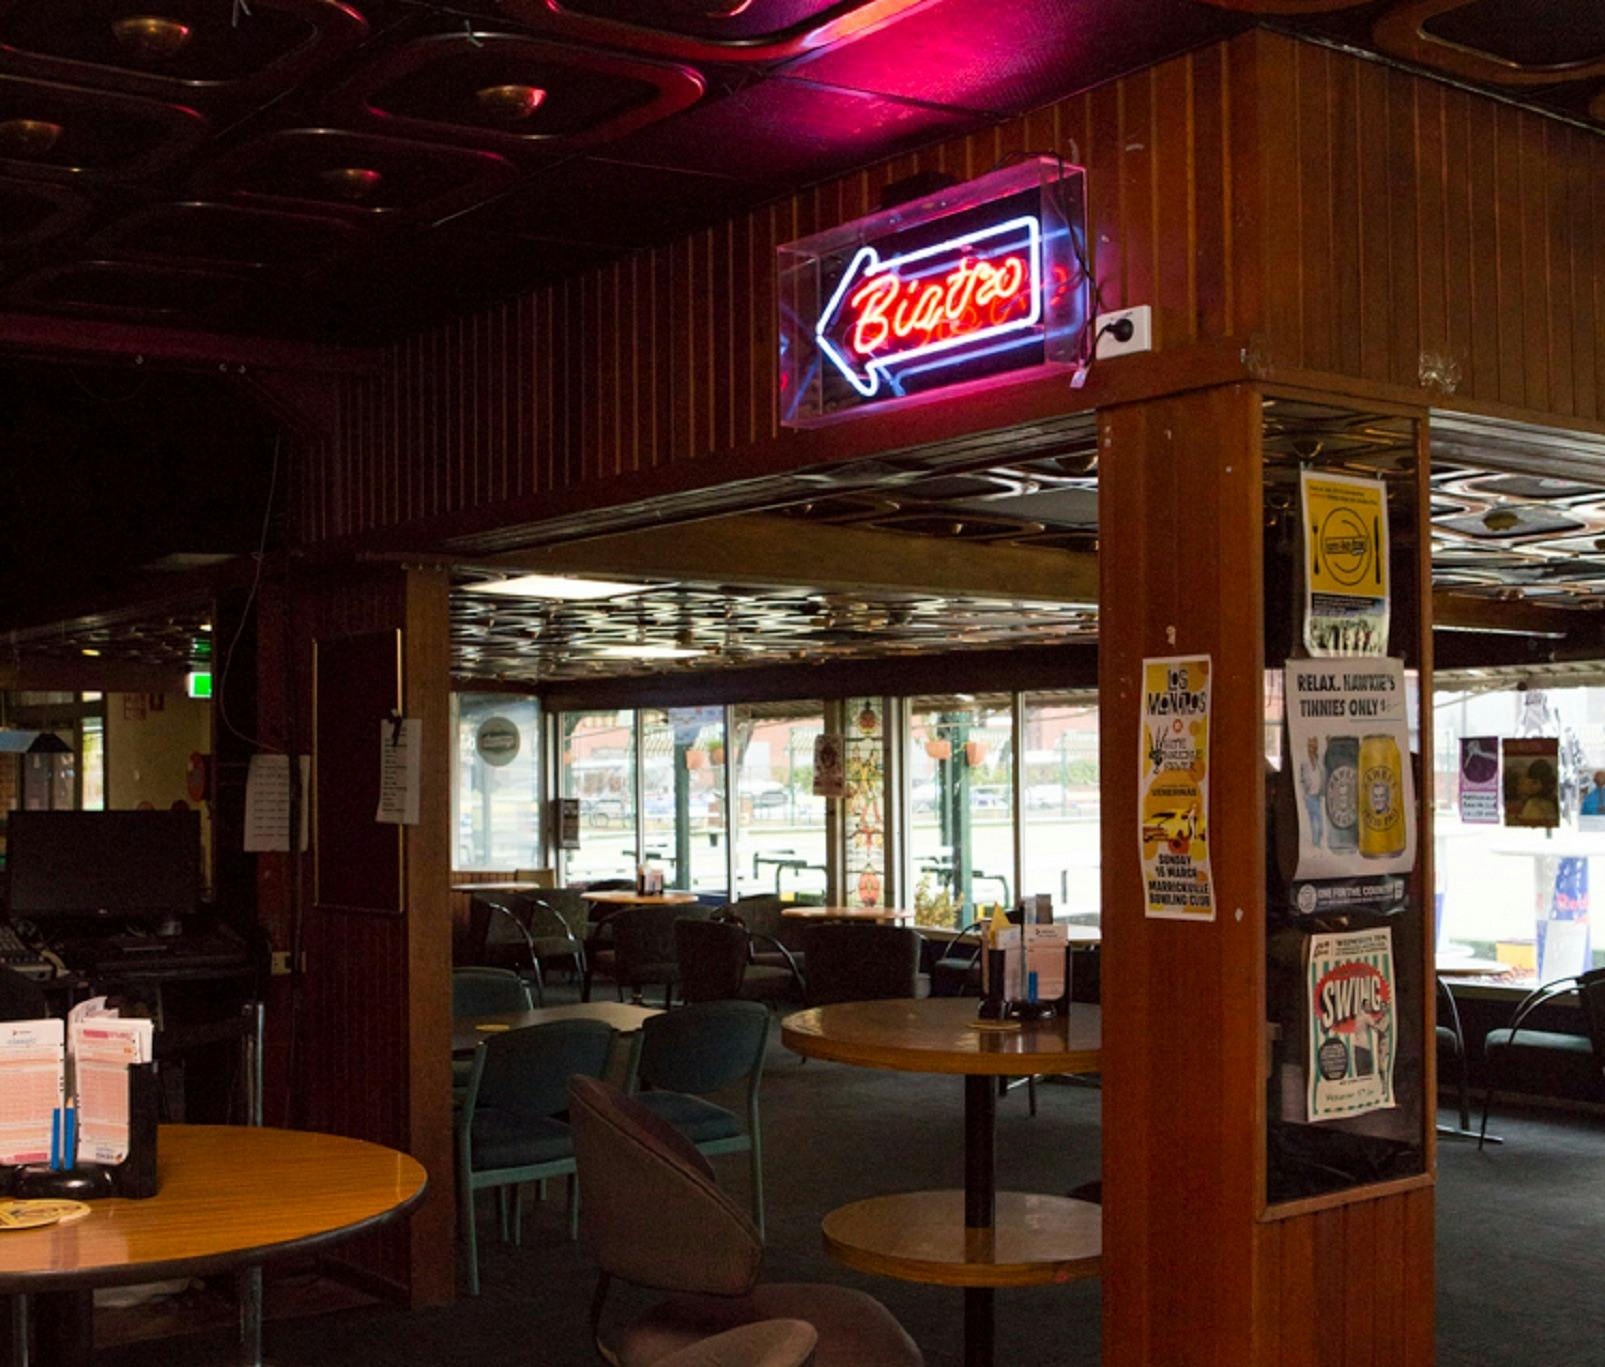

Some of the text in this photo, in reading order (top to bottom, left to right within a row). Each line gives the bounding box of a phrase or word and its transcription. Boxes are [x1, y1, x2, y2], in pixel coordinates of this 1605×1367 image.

[851, 255, 1023, 354] Bistro
[1167, 668, 1189, 691] LOS
[1297, 673, 1341, 692] RELAX.
[1300, 699, 1345, 718] TINNIES
[1349, 698, 1378, 717] ONLY
[1167, 867, 1197, 879] MARCH
[1322, 974, 1381, 1028] SWING
